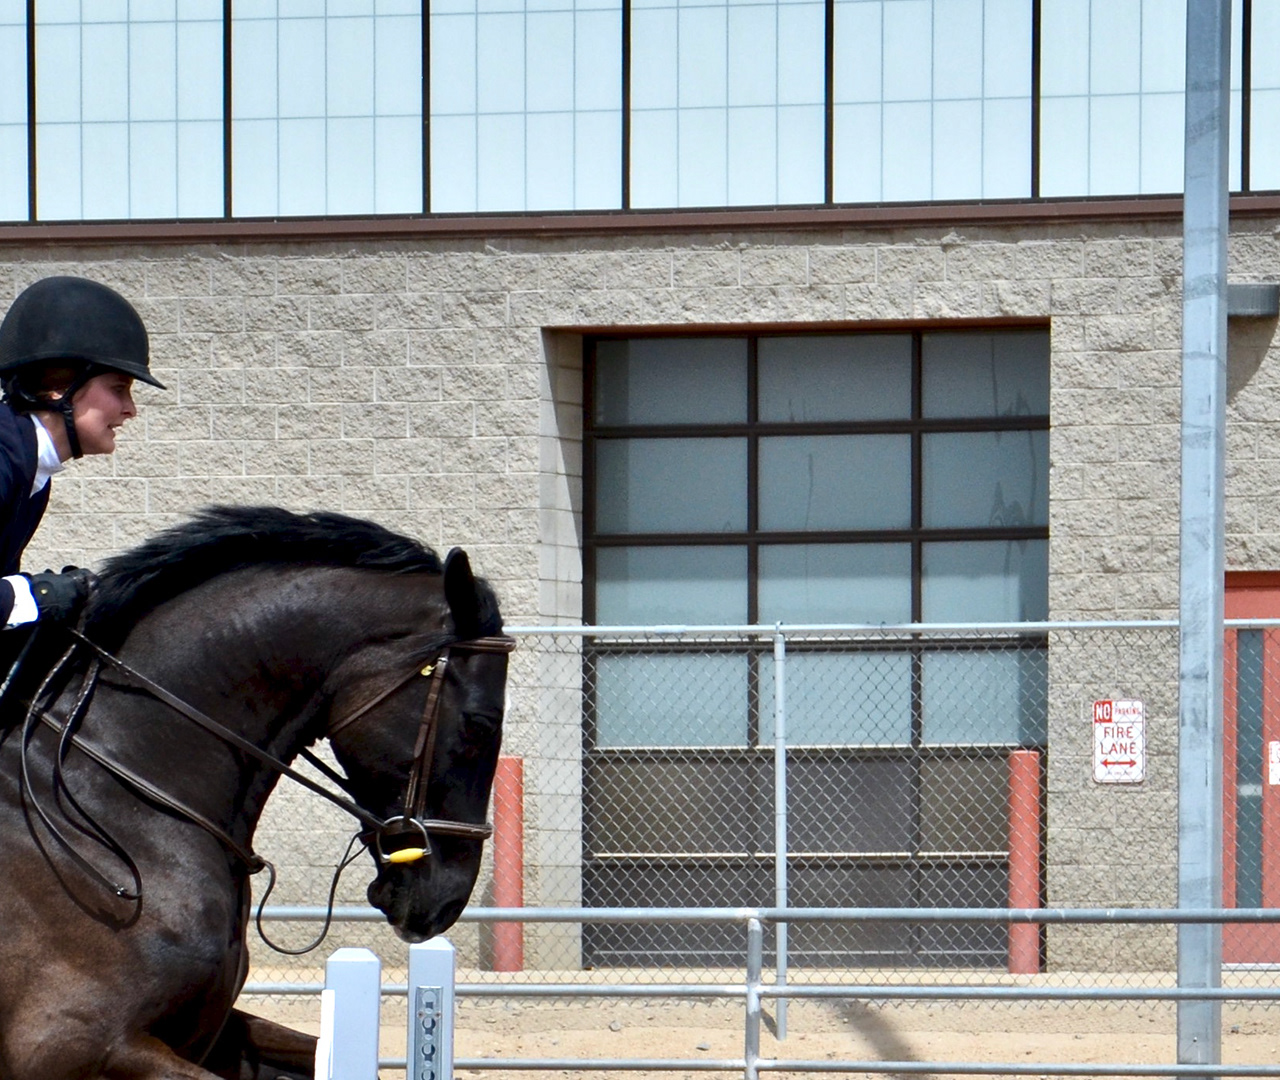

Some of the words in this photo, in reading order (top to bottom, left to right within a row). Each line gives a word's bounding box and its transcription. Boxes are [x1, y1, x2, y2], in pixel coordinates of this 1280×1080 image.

[1095, 703, 1111, 720] NO
[1104, 726, 1134, 738] FIRE
[1100, 742, 1137, 755] LANE
